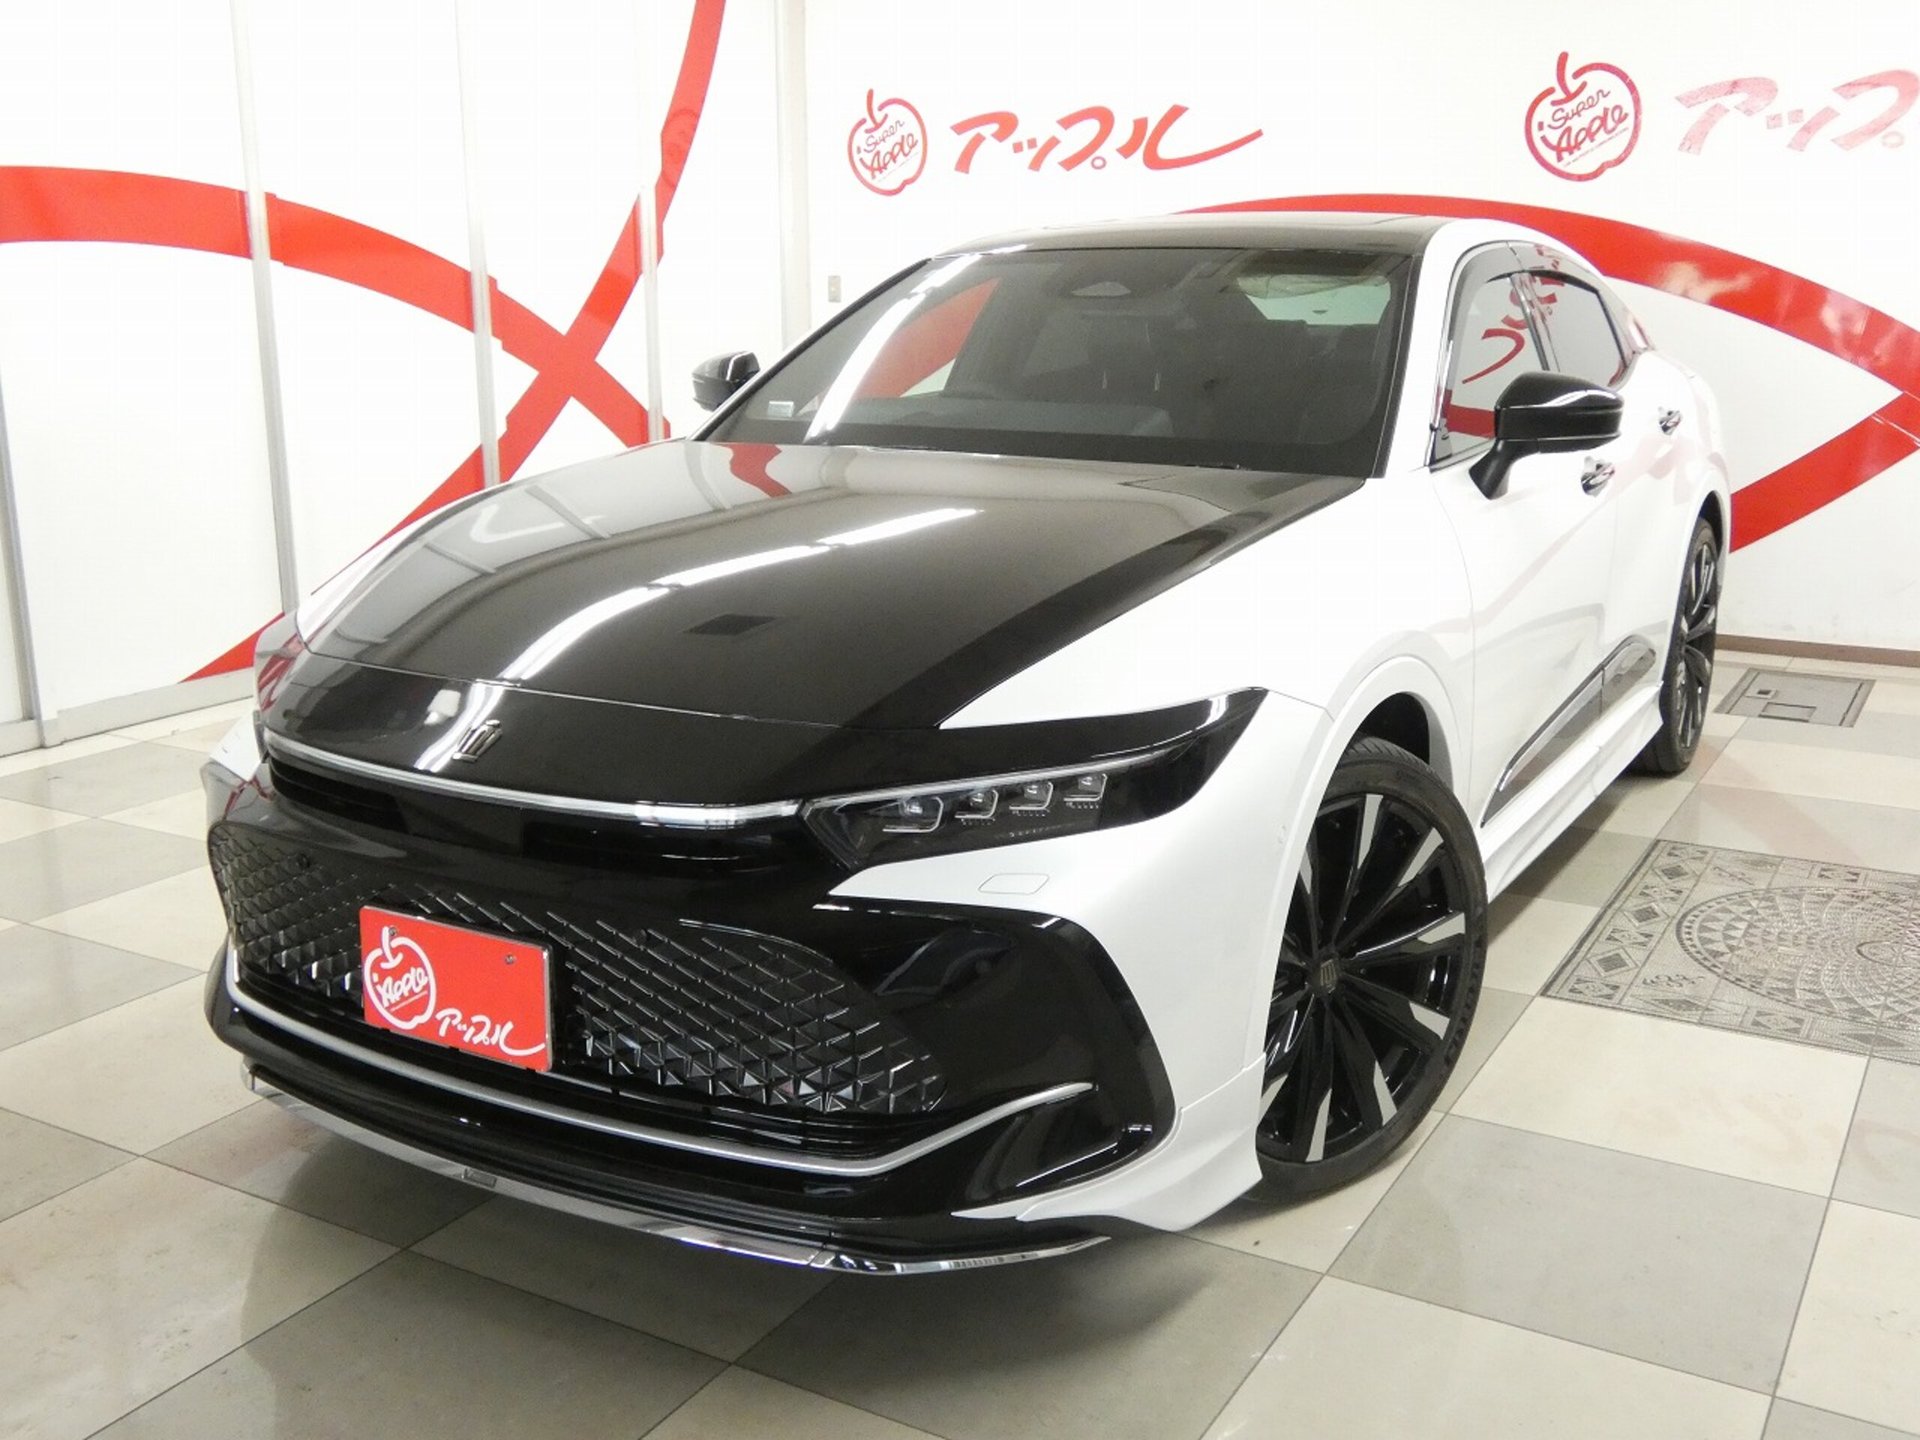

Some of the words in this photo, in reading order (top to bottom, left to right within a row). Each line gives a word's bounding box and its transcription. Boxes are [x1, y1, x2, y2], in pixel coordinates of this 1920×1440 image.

[1547, 89, 1611, 130] Super
[859, 133, 919, 179] Apple
[863, 120, 905, 153] Super
[950, 103, 1264, 174] アップル
[1540, 104, 1629, 163] Apple
[375, 966, 429, 1009] Apple
[435, 1007, 546, 1057] アップル
